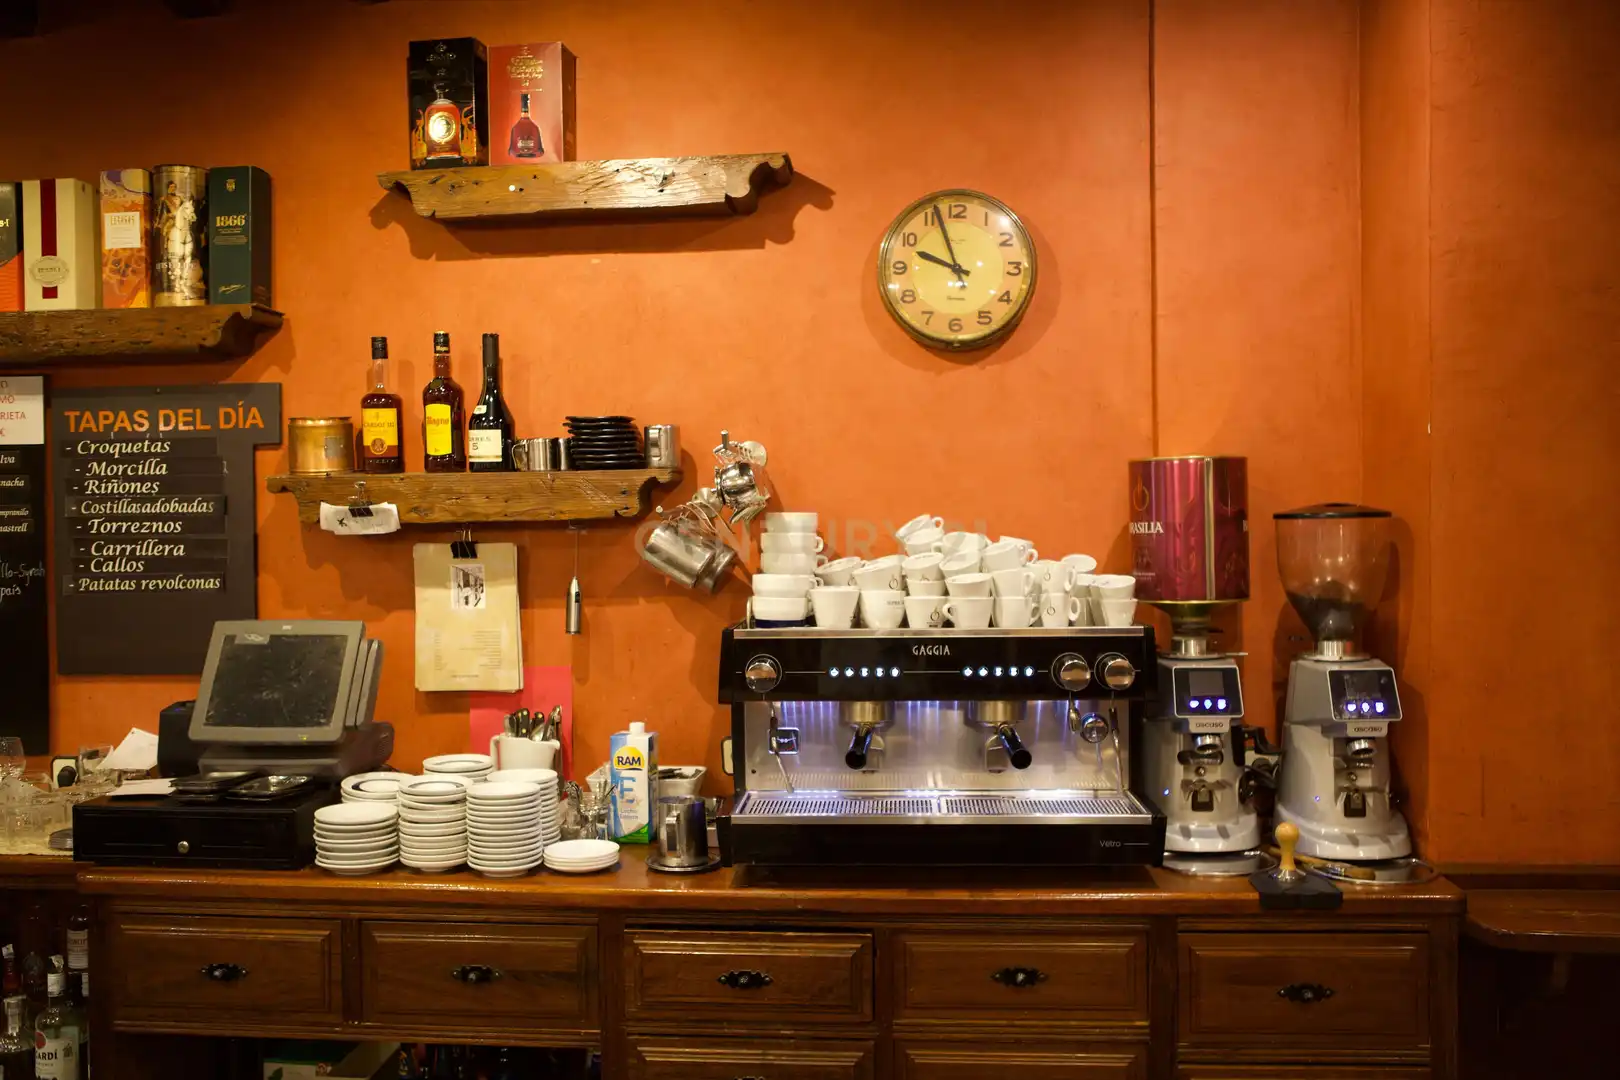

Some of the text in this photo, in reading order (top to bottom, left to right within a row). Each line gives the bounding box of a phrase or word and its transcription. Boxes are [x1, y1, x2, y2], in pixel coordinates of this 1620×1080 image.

[924, 211, 936, 226] 11
[949, 204, 968, 219] 12
[983, 212, 989, 226] 1
[215, 215, 245, 227] 1866
[902, 233, 918, 247] 10
[999, 232, 1014, 247] 2
[892, 261, 907, 275] 9
[1006, 261, 1022, 276] 3
[900, 289, 916, 304] 8
[997, 291, 1012, 304] 4
[921, 311, 934, 325] 7
[948, 318, 963, 332] 6
[977, 311, 993, 325] 5
[64, 400, 265, 433] TAPAS DEL DÍA
[77, 439, 170, 458] Croquetas
[472, 442, 479, 451] 5
[85, 458, 168, 476] Morcilla
[84, 479, 160, 495] Riñones
[88, 517, 183, 534] Torreznos
[90, 539, 185, 556] Carrillera
[90, 557, 145, 573] Callos
[79, 574, 221, 591] Patatas revolconas
[912, 644, 951, 656] GAGGIA
[616, 755, 642, 766] RAM
[1100, 840, 1122, 848] Vetro
